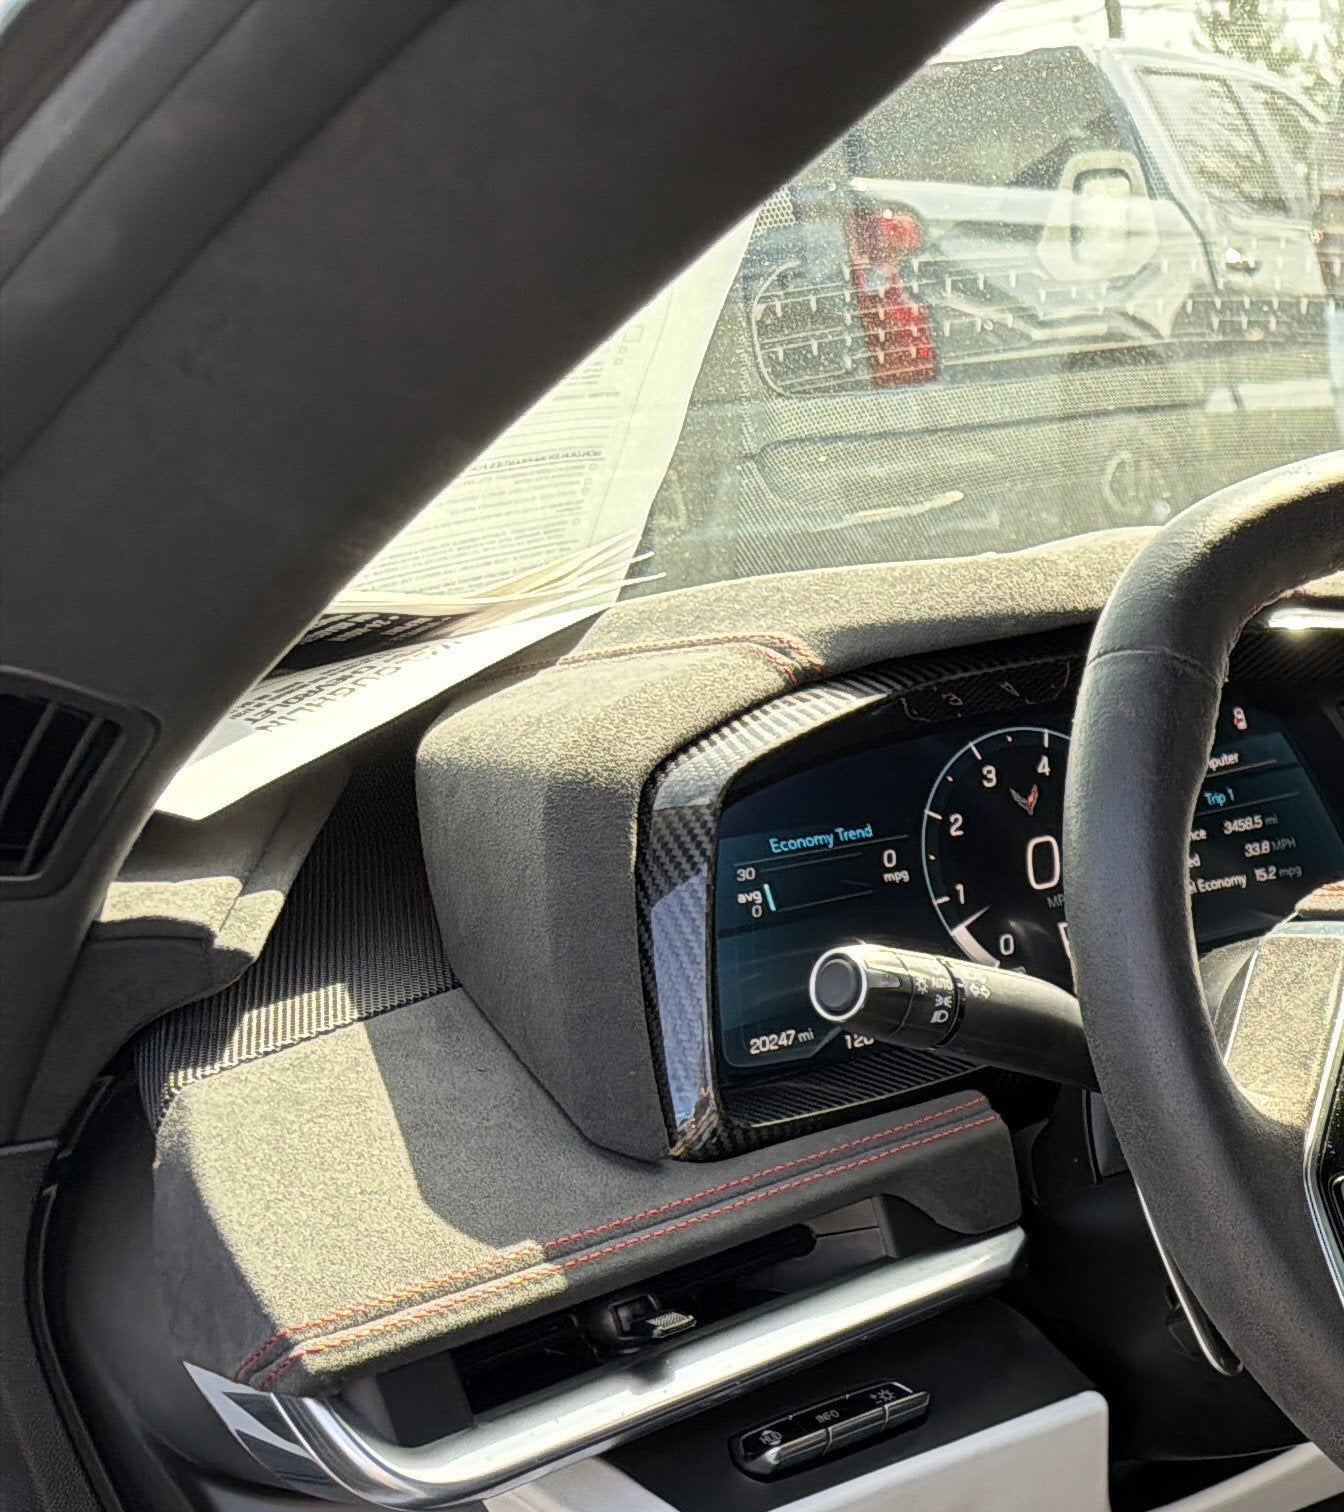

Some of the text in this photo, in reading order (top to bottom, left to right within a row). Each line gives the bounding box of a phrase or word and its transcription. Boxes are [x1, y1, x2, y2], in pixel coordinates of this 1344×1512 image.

[1037, 755, 1051, 776] 4
[982, 765, 997, 787] 3
[1204, 791, 1227, 806] Trip
[950, 813, 965, 837] 2
[1223, 814, 1263, 835] 3458.5
[768, 824, 873, 853] Economy Trend
[1244, 839, 1270, 858] 33.8
[883, 850, 897, 868] 0
[1027, 835, 1061, 890] 0
[736, 867, 756, 882] 30
[883, 870, 910, 883] mpg
[1254, 865, 1303, 882] 15.2 mpg
[1196, 874, 1247, 893] Economy
[737, 890, 763, 904] avg
[955, 883, 965, 905] 1
[752, 904, 762, 918] 0
[999, 933, 1015, 955] 0
[749, 1027, 815, 1055] 20247 mi
[814, 1409, 840, 1424] INFO
